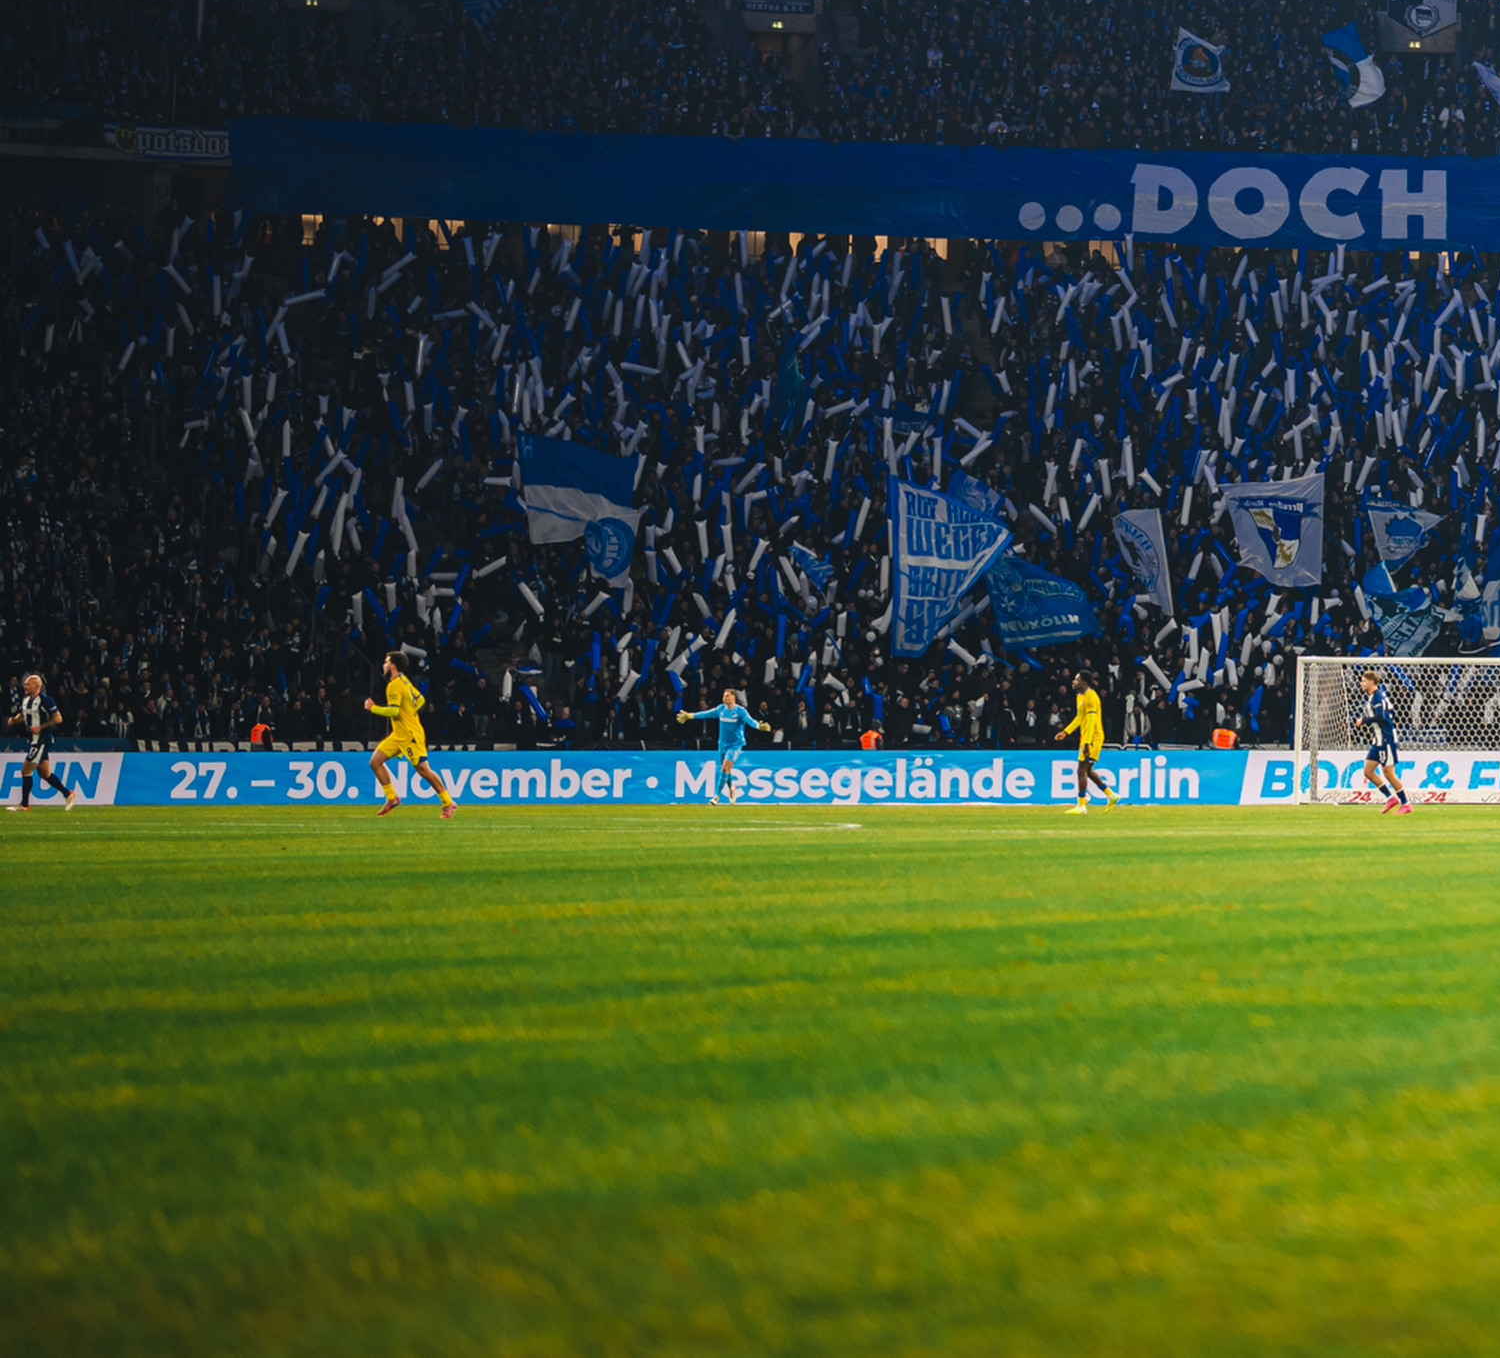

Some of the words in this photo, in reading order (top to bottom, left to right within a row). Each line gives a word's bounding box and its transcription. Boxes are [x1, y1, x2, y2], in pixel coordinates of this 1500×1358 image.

[136, 127, 229, 158] potsda
[171, 761, 237, 799] 27.
[288, 761, 358, 799] 30.
[374, 758, 632, 799] November
[674, 757, 1035, 805] Messegelände
[1051, 755, 1200, 799] Berlin
